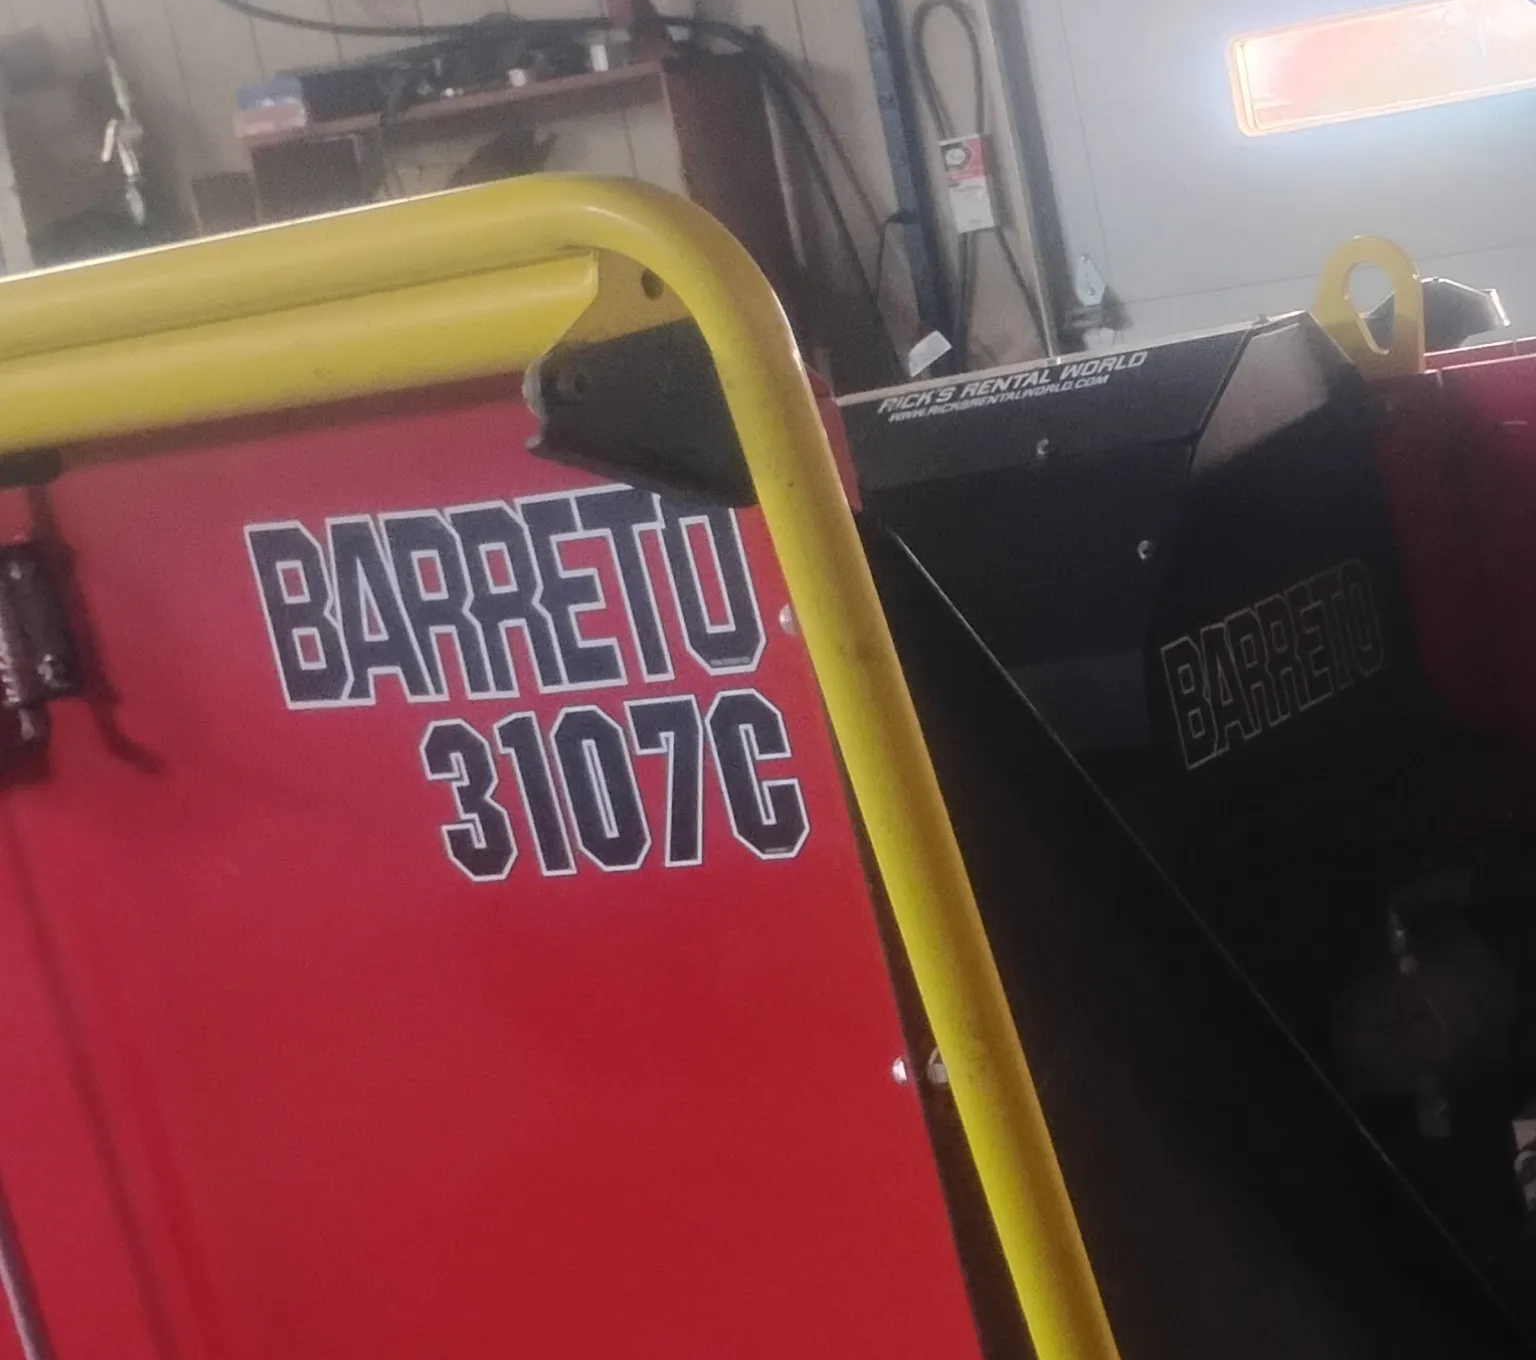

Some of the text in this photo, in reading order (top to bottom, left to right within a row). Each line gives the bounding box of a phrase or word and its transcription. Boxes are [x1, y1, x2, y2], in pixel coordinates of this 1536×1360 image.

[877, 351, 1149, 415] RICK'S RENTAL WORLD
[1160, 557, 1387, 771] BARRETO
[419, 687, 810, 882] 3107C
